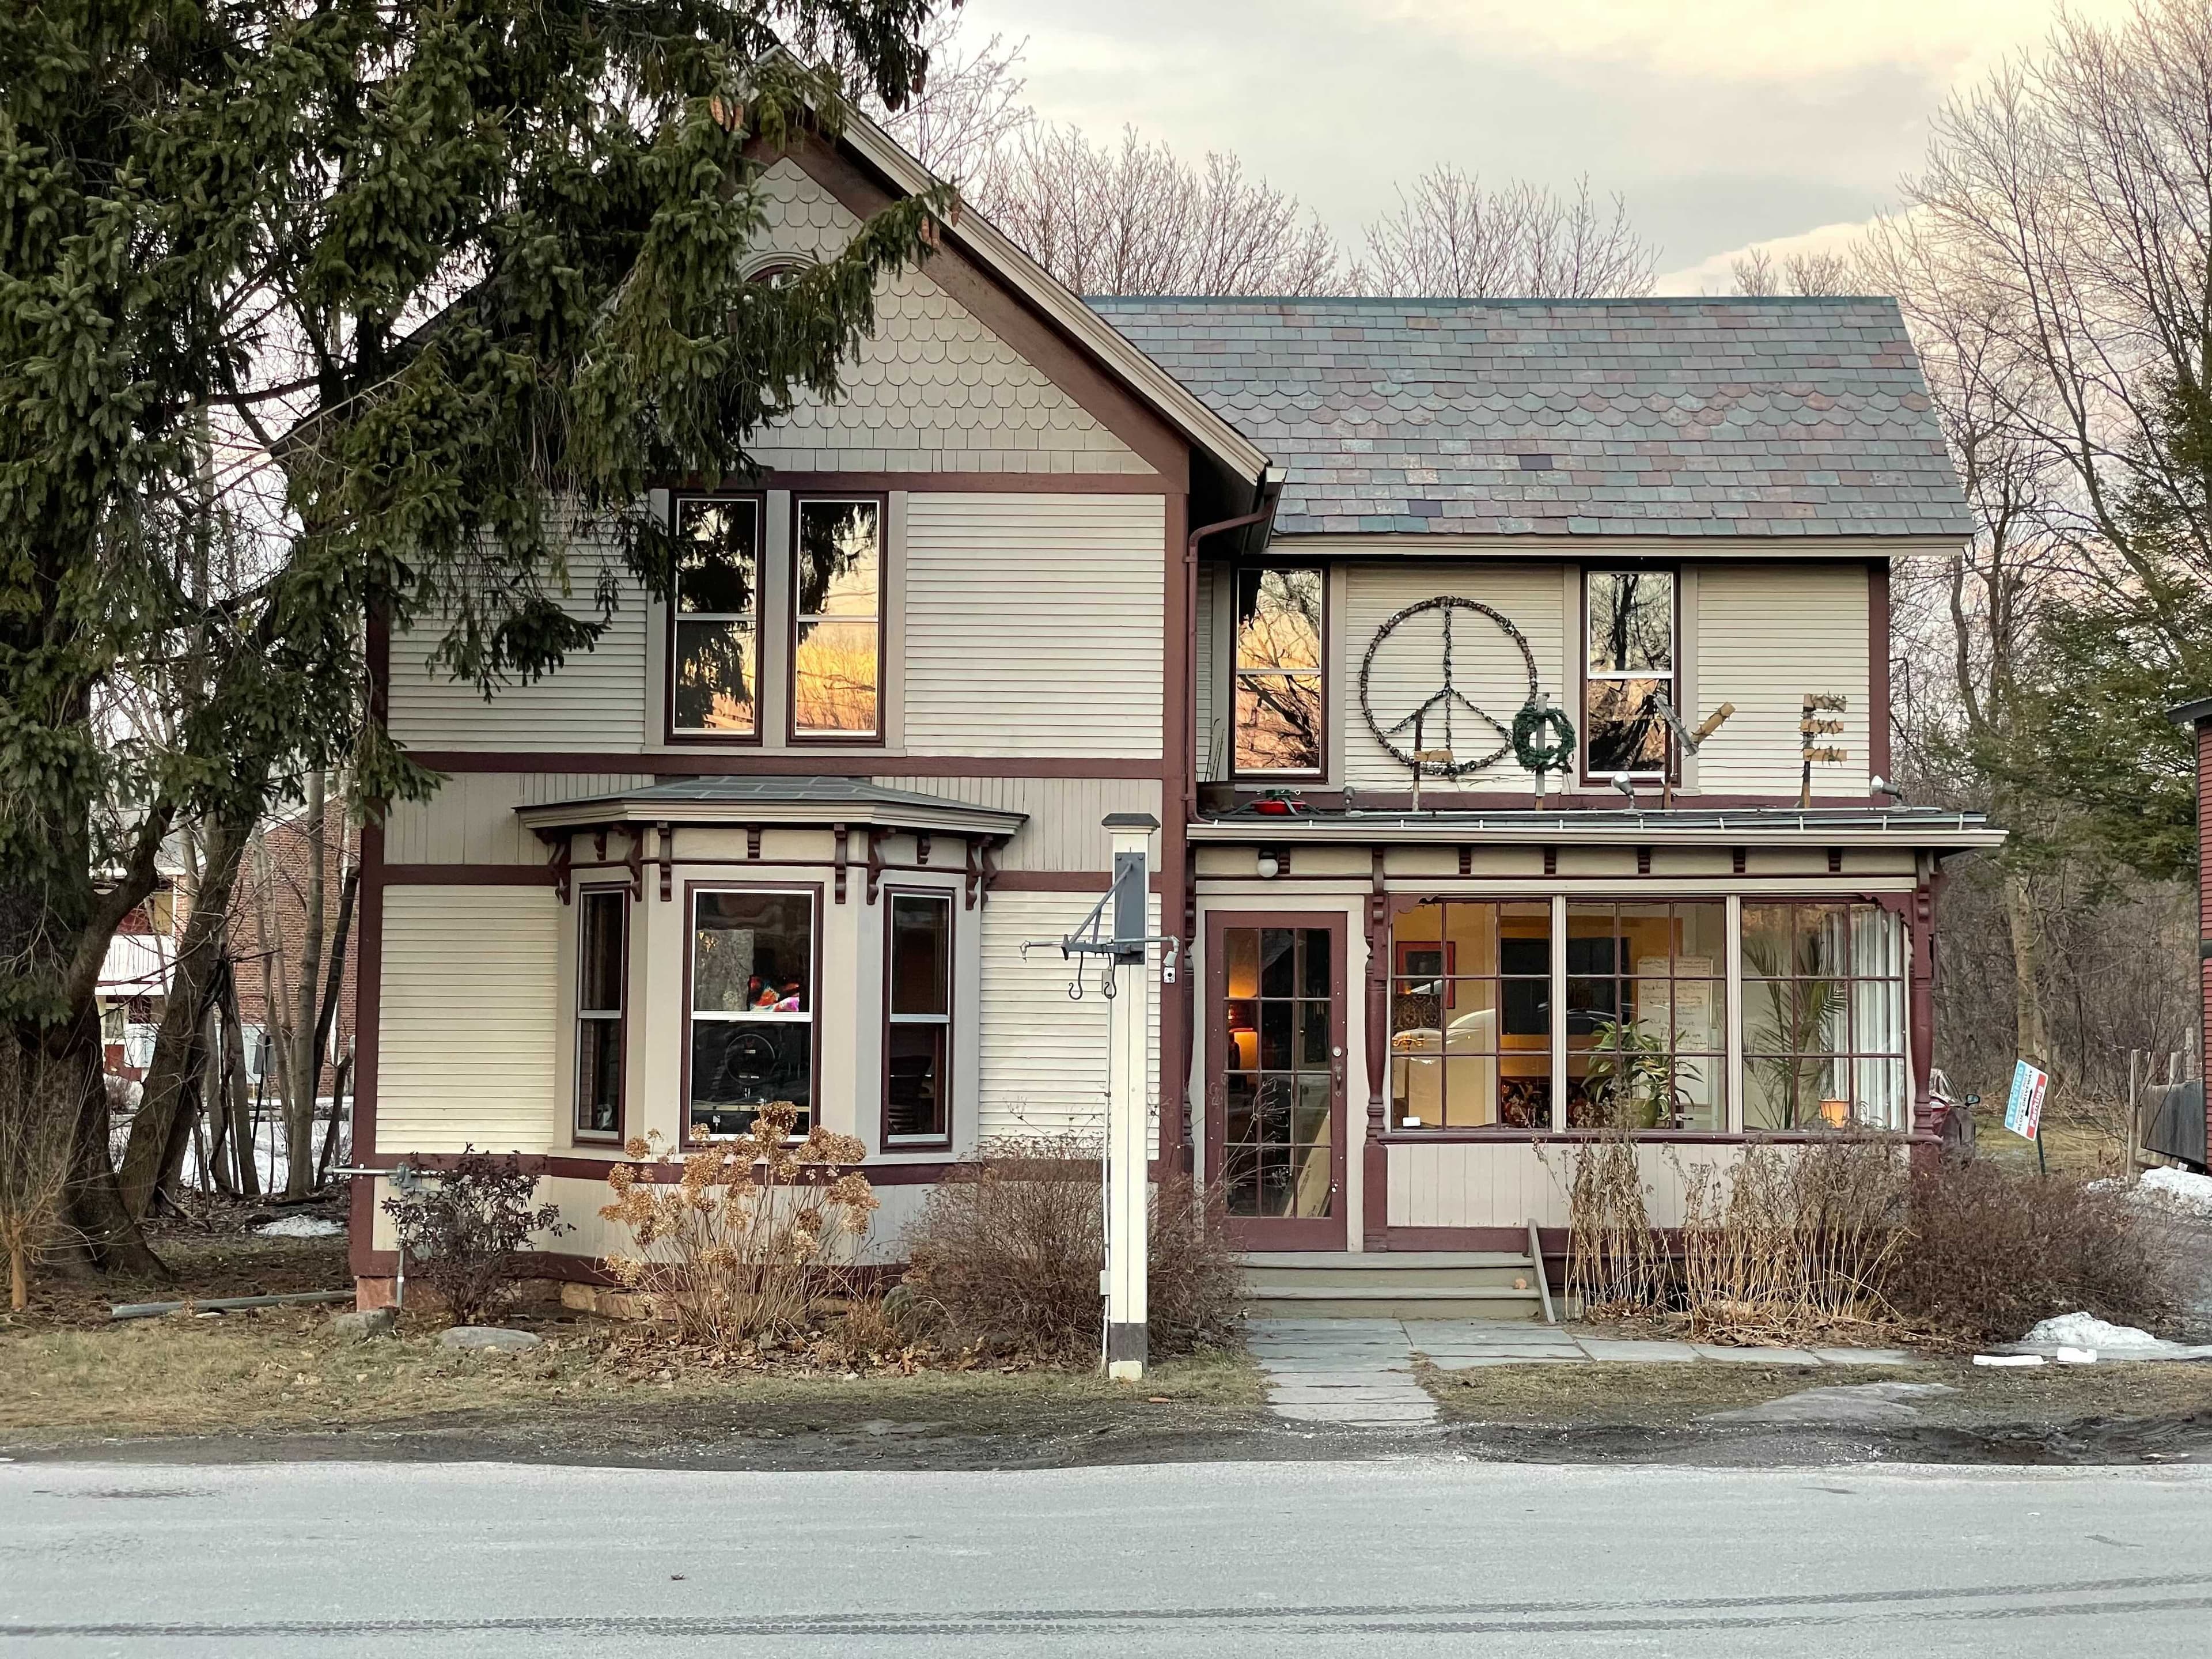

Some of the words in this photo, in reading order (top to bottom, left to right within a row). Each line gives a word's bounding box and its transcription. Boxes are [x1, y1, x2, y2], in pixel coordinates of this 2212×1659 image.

[2008, 1065, 2024, 1124] STITCHED
[2022, 1069, 2032, 1107] DRIVEWAY
[2029, 1085, 2043, 1128] Parking
